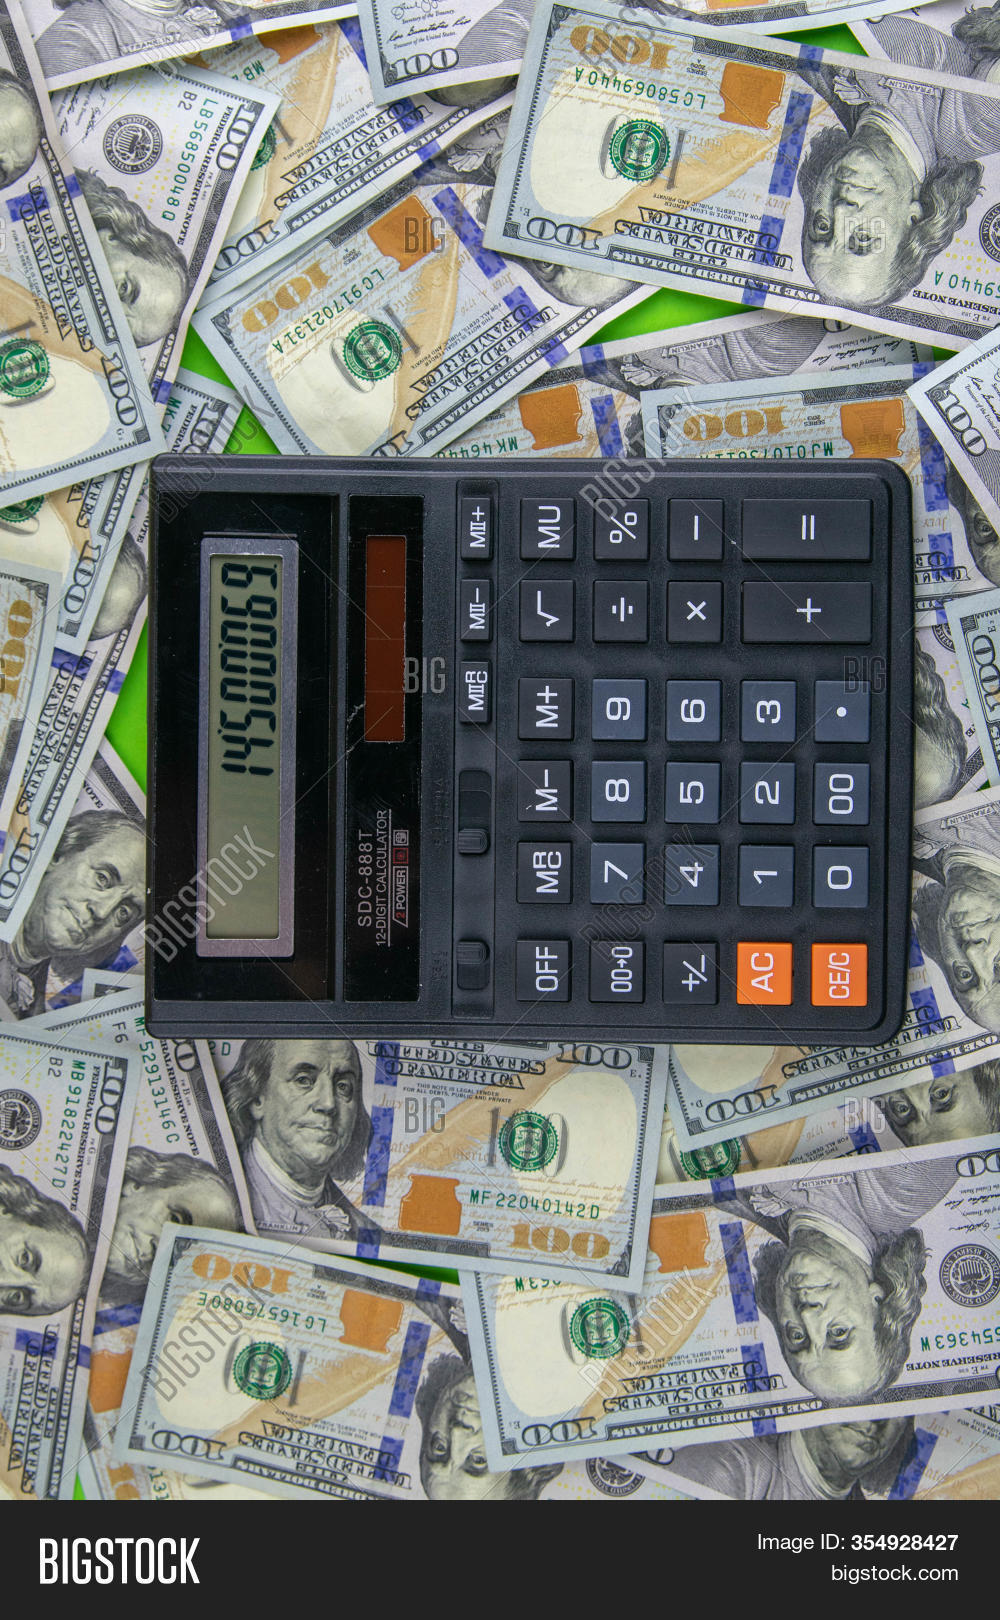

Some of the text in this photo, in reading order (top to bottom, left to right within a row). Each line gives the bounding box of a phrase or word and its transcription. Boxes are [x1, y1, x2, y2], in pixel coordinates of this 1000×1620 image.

[391, 48, 459, 80] 100
[570, 24, 677, 70] 100
[216, 104, 259, 171] 100
[176, 211, 193, 246] NOTE
[208, 218, 281, 275] 100
[526, 217, 603, 250] 100
[241, 260, 332, 333] 100
[912, 289, 943, 302] NOTE
[101, 352, 138, 426] 100
[683, 406, 788, 442] 100
[944, 391, 988, 457] 100
[538, 506, 560, 548] MU
[609, 512, 638, 544] %
[63, 540, 101, 614] 100
[536, 686, 558, 727] M+
[606, 698, 631, 721] 9
[681, 699, 706, 723] 6
[757, 700, 781, 724] 3
[606, 779, 630, 803] 8
[680, 781, 704, 804] 5
[756, 781, 779, 804] 2
[829, 774, 854, 815] 00
[358, 829, 373, 927] SDC-888T
[376, 810, 387, 946] 12-DIGIT CALCULATOR
[396, 869, 406, 910] POWER
[605, 861, 628, 883] 7
[680, 862, 704, 888] 4
[754, 871, 778, 883] 1
[828, 866, 853, 889] 0
[536, 947, 559, 992] OFF
[751, 952, 774, 993] AC
[828, 952, 851, 999] CE/C
[556, 1042, 632, 1069] 100
[95, 1060, 124, 1135] 100
[705, 1084, 781, 1124] 100
[510, 1222, 612, 1259] 100
[191, 1253, 296, 1293] 100
[905, 1359, 939, 1372] NOTE
[152, 1430, 228, 1460] 100
[521, 1415, 598, 1446] 100
